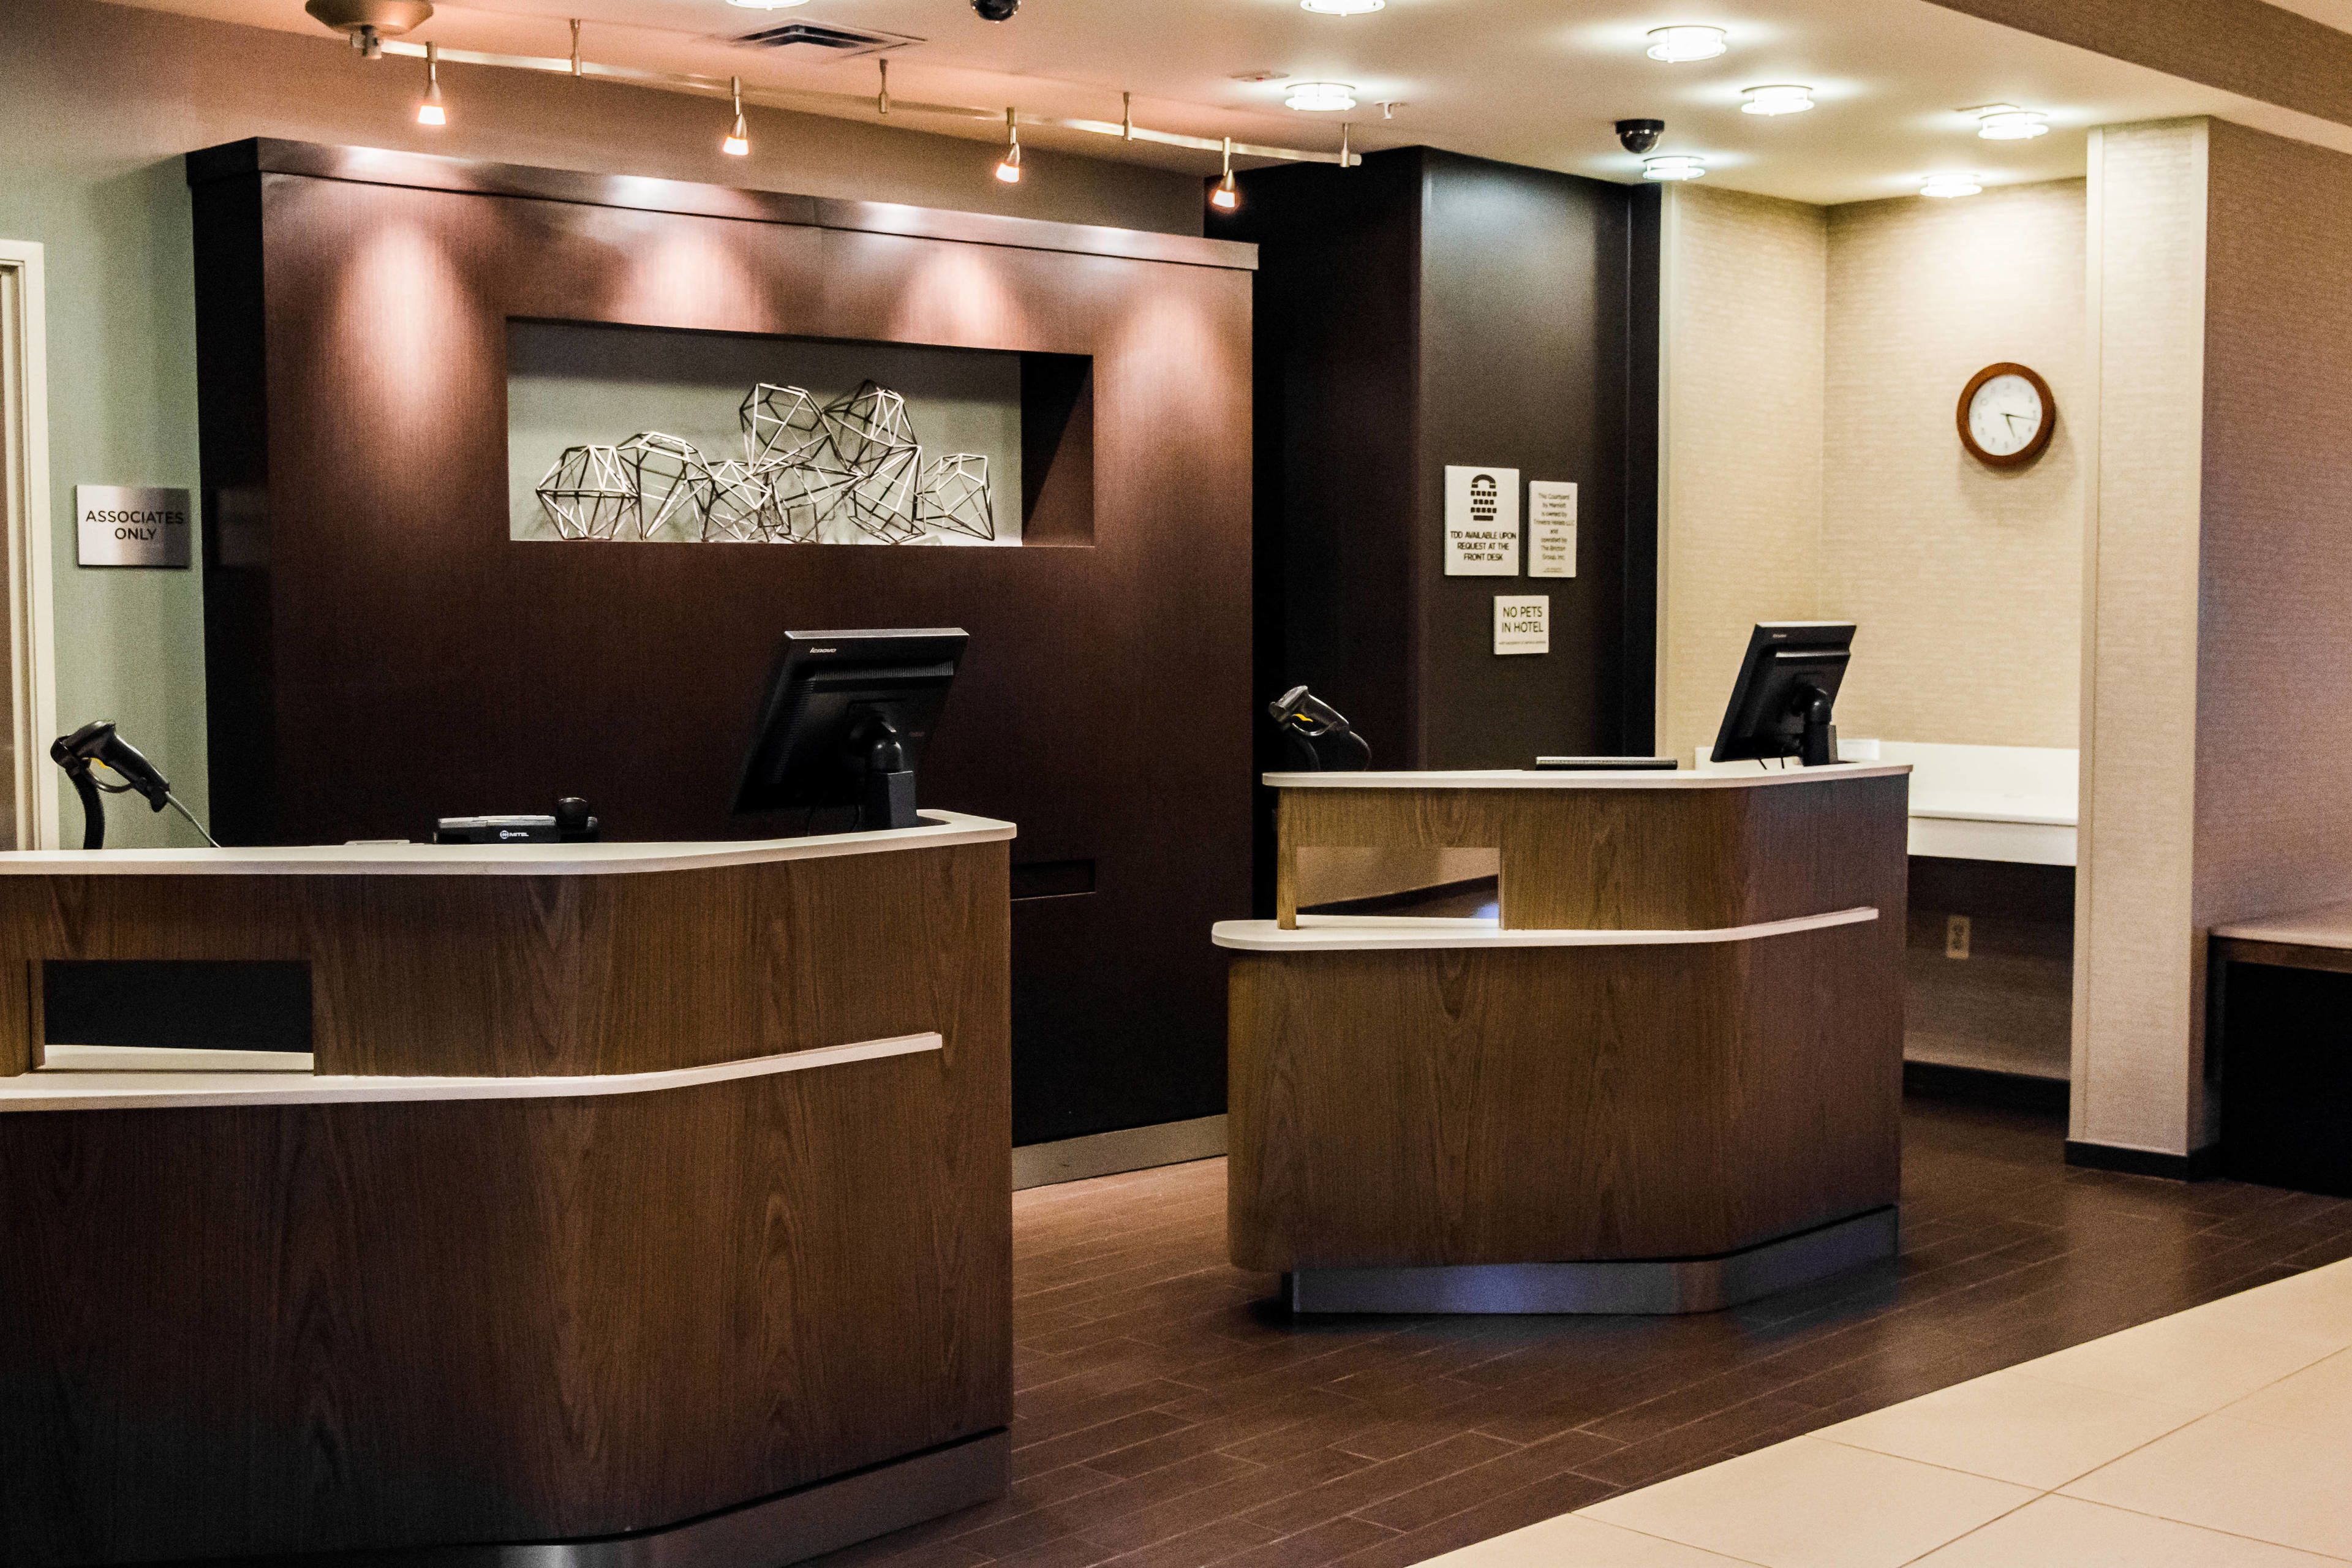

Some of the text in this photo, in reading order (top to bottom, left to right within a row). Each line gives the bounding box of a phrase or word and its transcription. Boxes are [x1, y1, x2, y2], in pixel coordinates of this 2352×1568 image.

[86, 510, 184, 524] ASSOCIATES
[115, 527, 157, 540] ONLY
[1503, 606, 1543, 617] NO PETS
[1501, 621, 1544, 633] IN HOTEL
